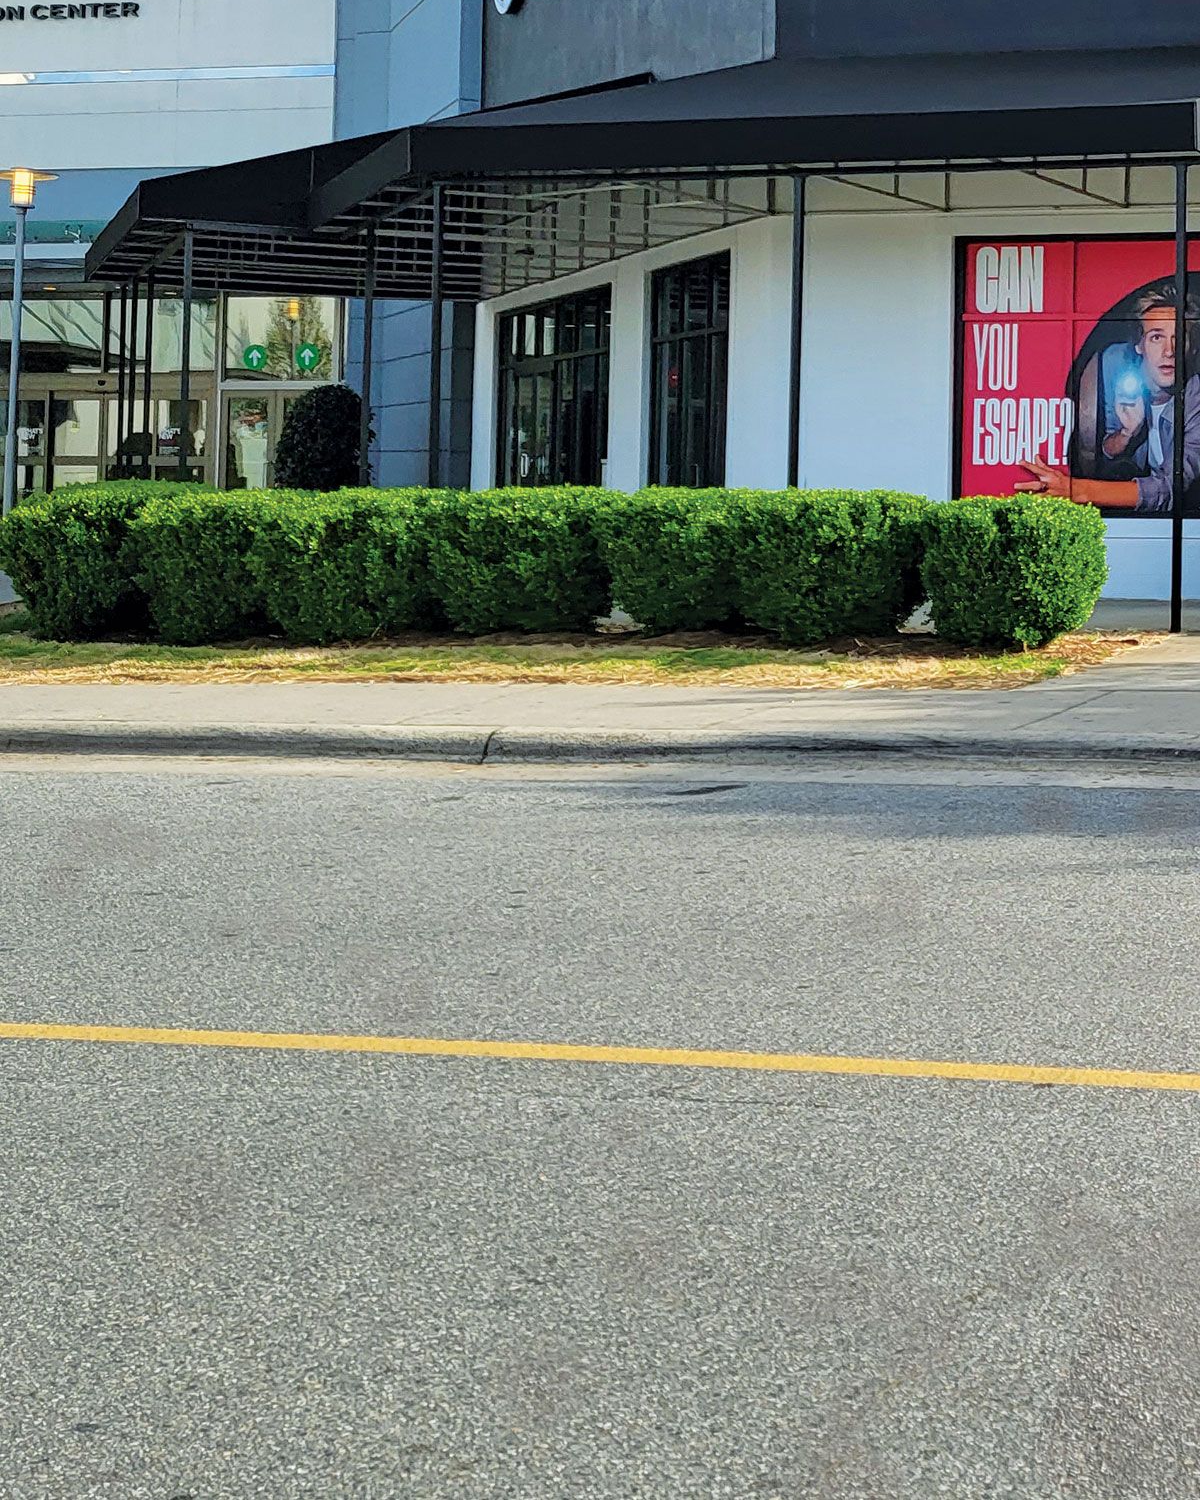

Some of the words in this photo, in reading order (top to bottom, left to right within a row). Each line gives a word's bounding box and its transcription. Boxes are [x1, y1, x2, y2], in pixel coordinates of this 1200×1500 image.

[30, 2, 140, 21] CENTER
[975, 245, 1045, 314] CAN
[973, 323, 1019, 391] YOU
[972, 397, 1075, 466] ESCAPE?
